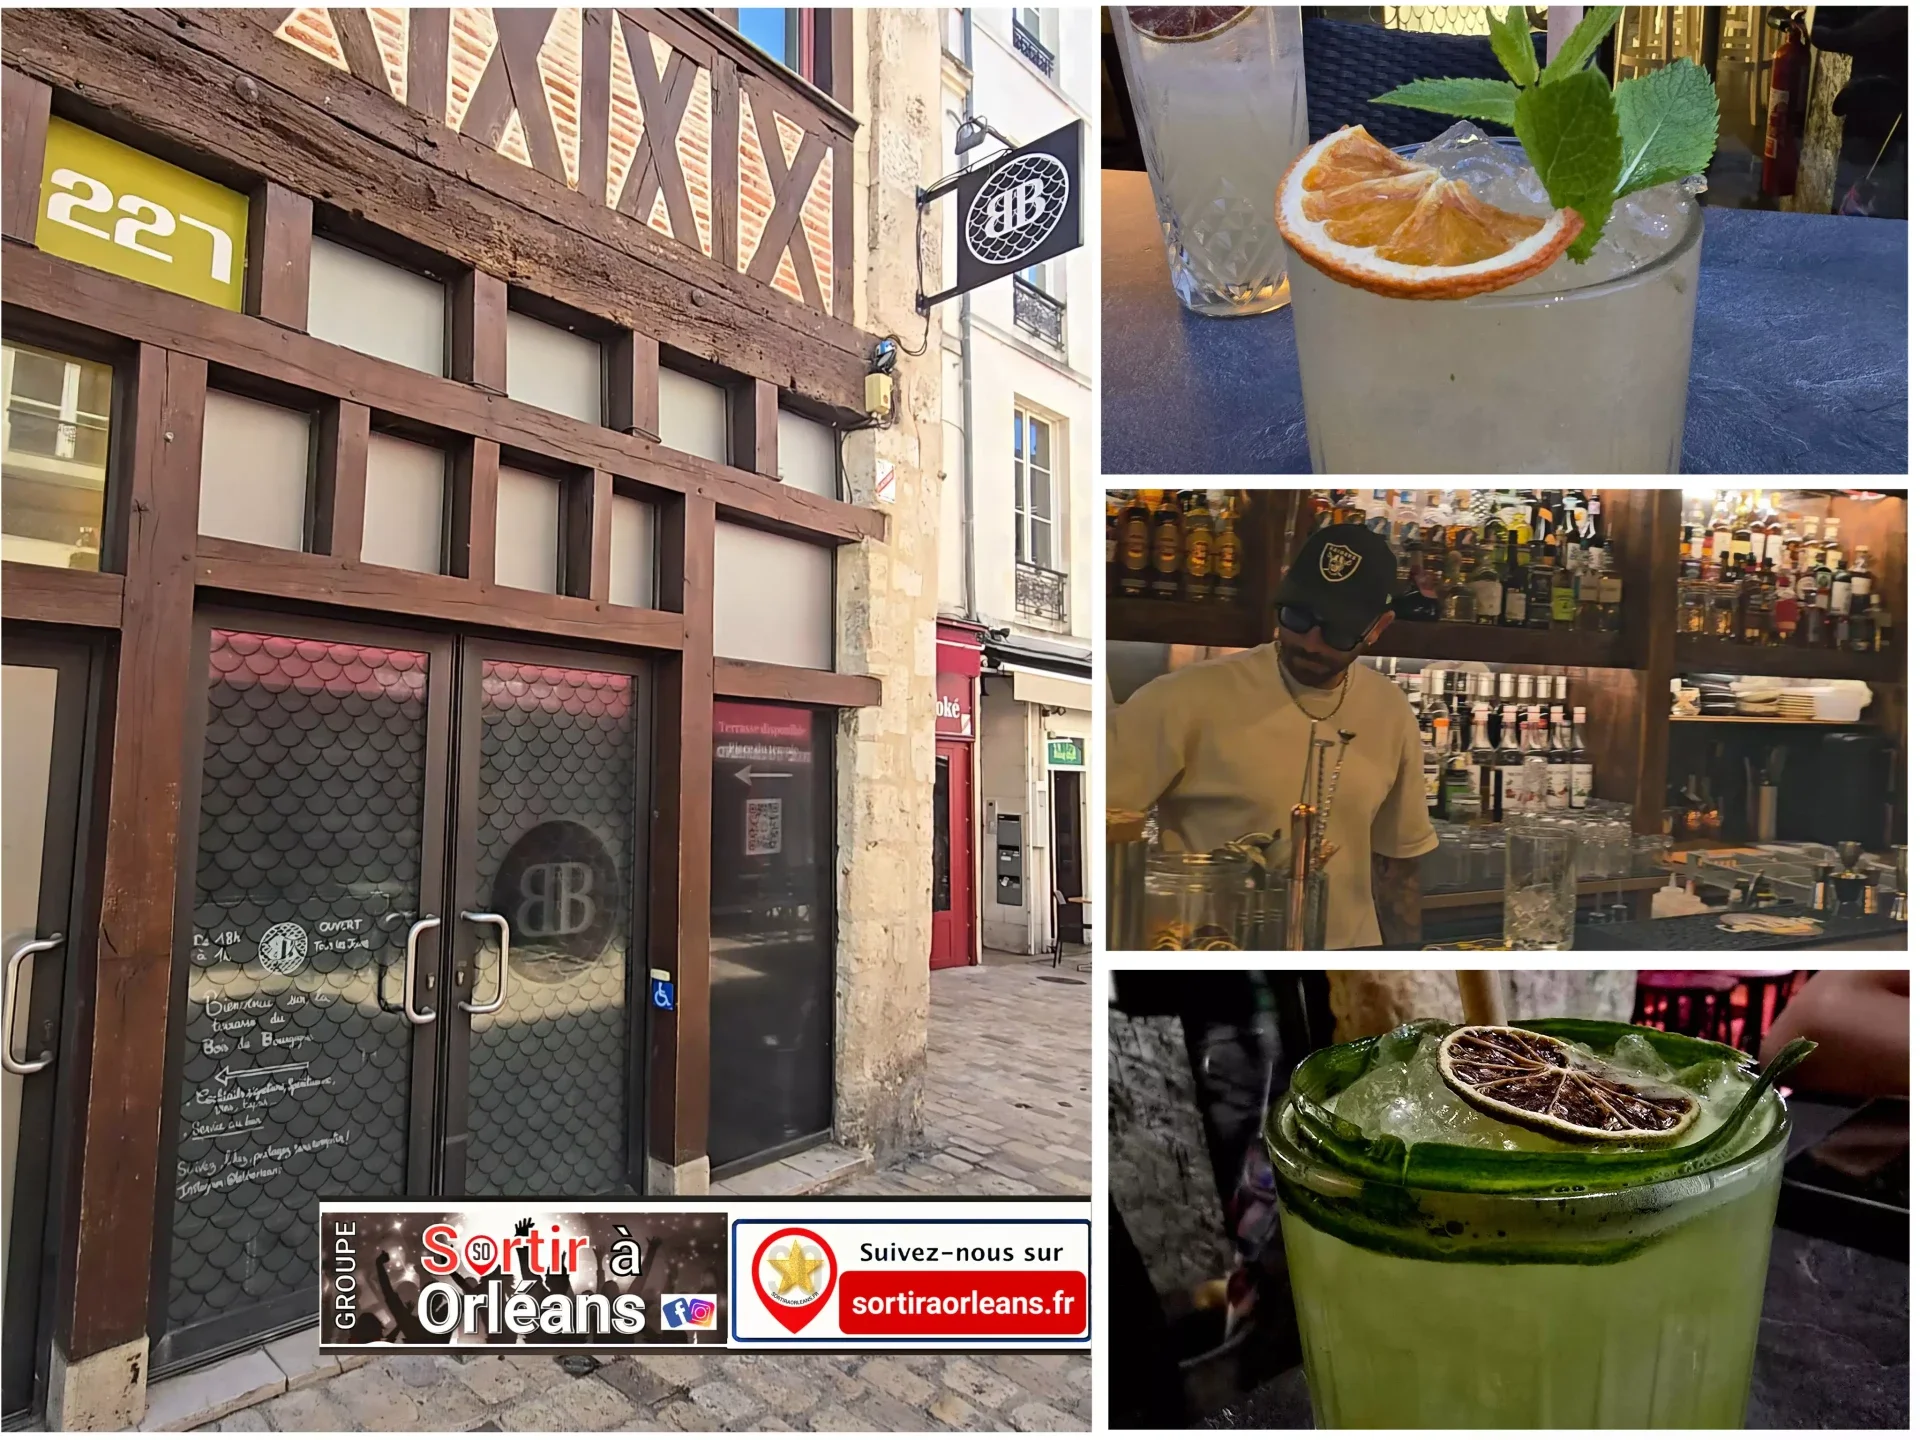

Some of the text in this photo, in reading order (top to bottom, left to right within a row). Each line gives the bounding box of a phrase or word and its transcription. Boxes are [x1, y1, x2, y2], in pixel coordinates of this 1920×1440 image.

[47, 168, 233, 285] 227
[719, 721, 759, 733] Terrasse
[319, 918, 363, 932] OUVERT
[214, 931, 241, 945] 18h
[314, 940, 333, 952] Tous
[196, 949, 207, 960] à
[270, 1012, 285, 1024] du
[191, 1120, 226, 1136] Service
[228, 1118, 243, 1129] au
